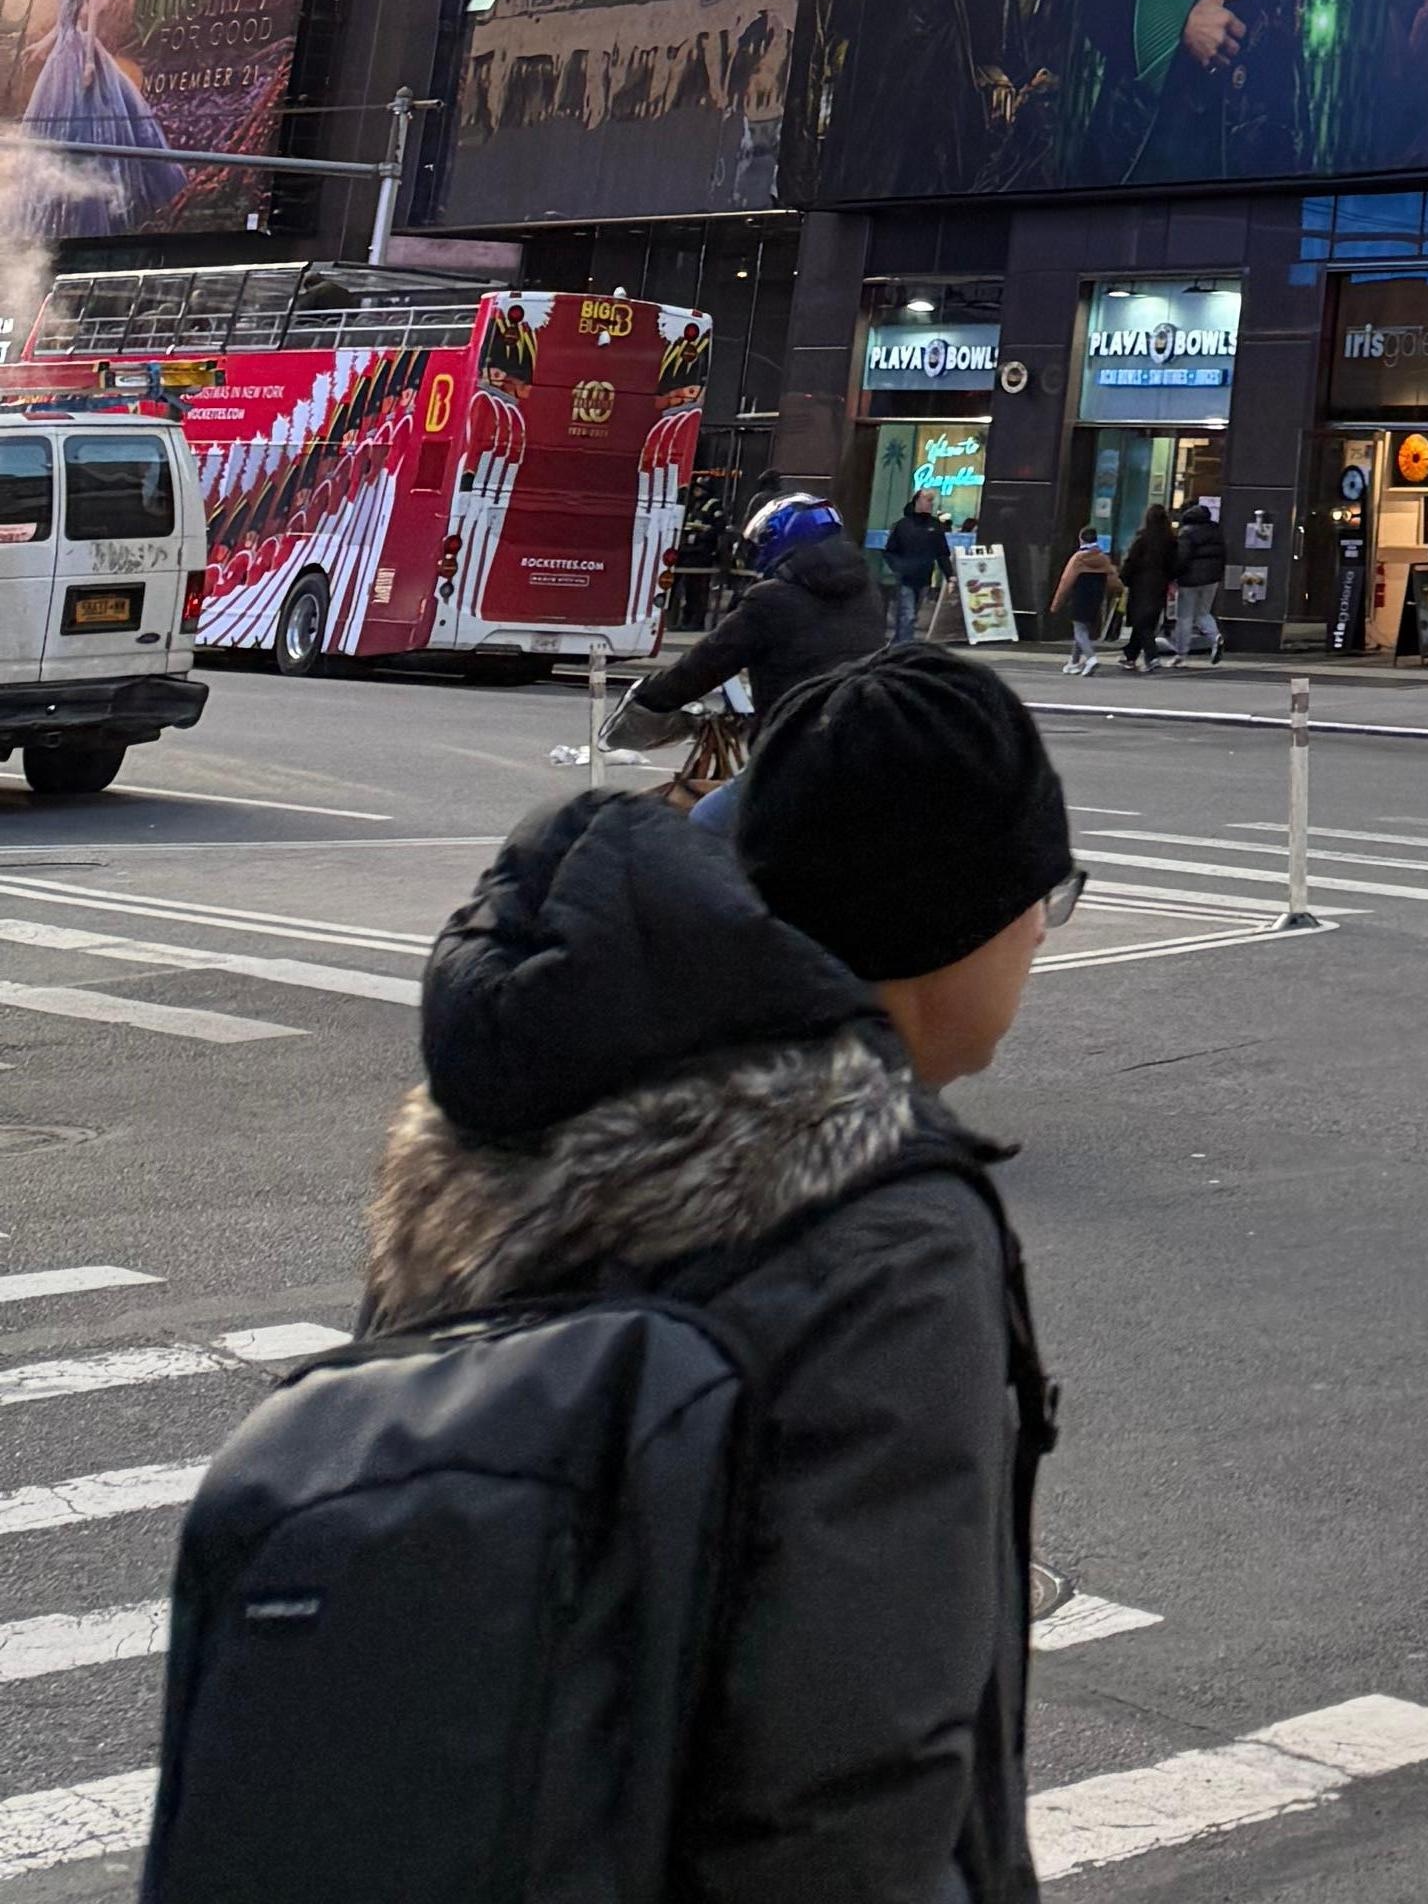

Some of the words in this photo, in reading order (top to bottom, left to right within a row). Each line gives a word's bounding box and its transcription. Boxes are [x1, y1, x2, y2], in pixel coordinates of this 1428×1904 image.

[160, 25, 200, 50] FOR
[210, 16, 273, 46] GOOD
[142, 67, 233, 94] NOVEMBER
[242, 64, 259, 86] 21
[581, 300, 611, 320] BIG
[1089, 330, 1148, 356] PLAYA
[1173, 330, 1238, 356] BOWLS
[870, 345, 923, 370] PLAYA
[521, 557, 605, 571] ROCKETTES.COM
